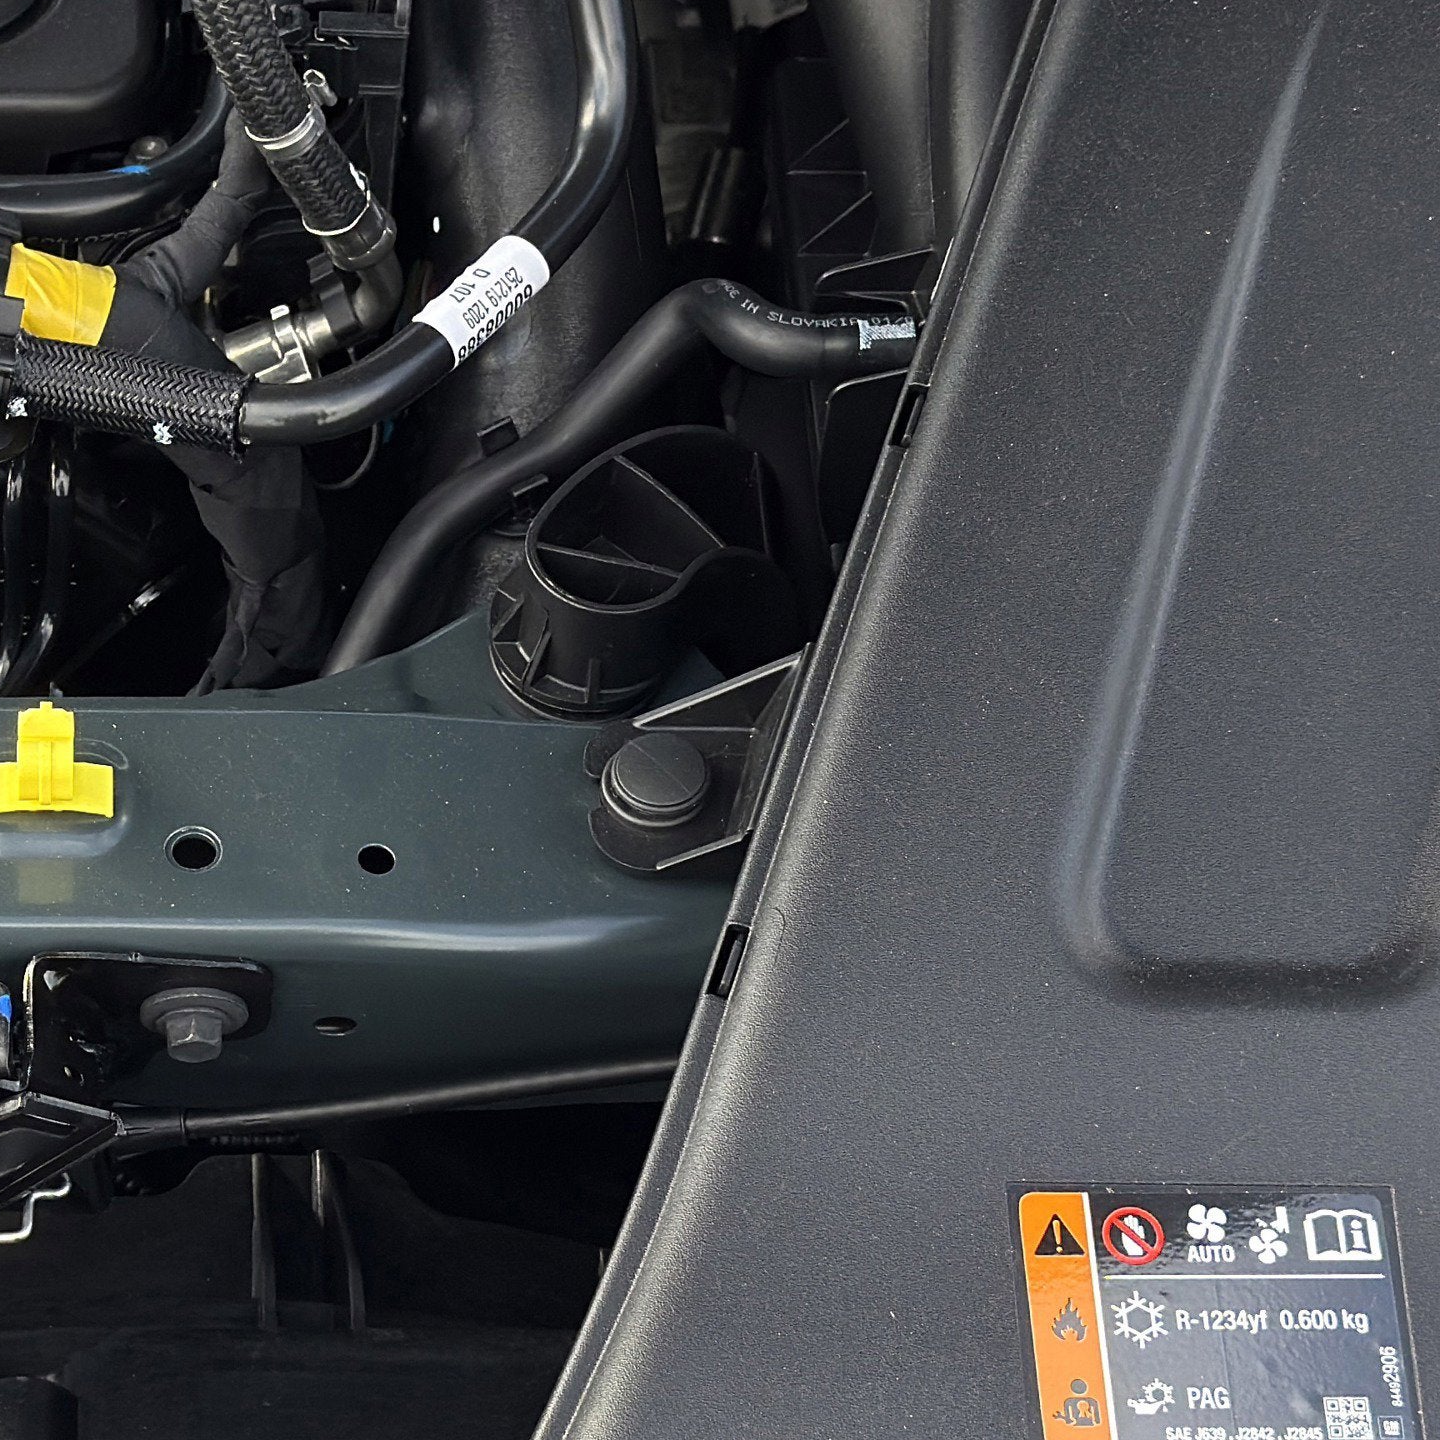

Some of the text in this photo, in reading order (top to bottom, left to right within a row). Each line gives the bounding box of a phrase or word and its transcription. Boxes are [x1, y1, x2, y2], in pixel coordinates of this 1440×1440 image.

[448, 282, 476, 303] 107
[462, 266, 524, 330] 251219 1209
[740, 298, 760, 314] IN
[766, 310, 861, 328] SLOVAKIA
[1187, 1244, 1236, 1263] AUTO
[1175, 1308, 1369, 1334] R-1234yf 0.600 kg
[1186, 1386, 1232, 1410] PAG
[1165, 1426, 1192, 1440] SAE
